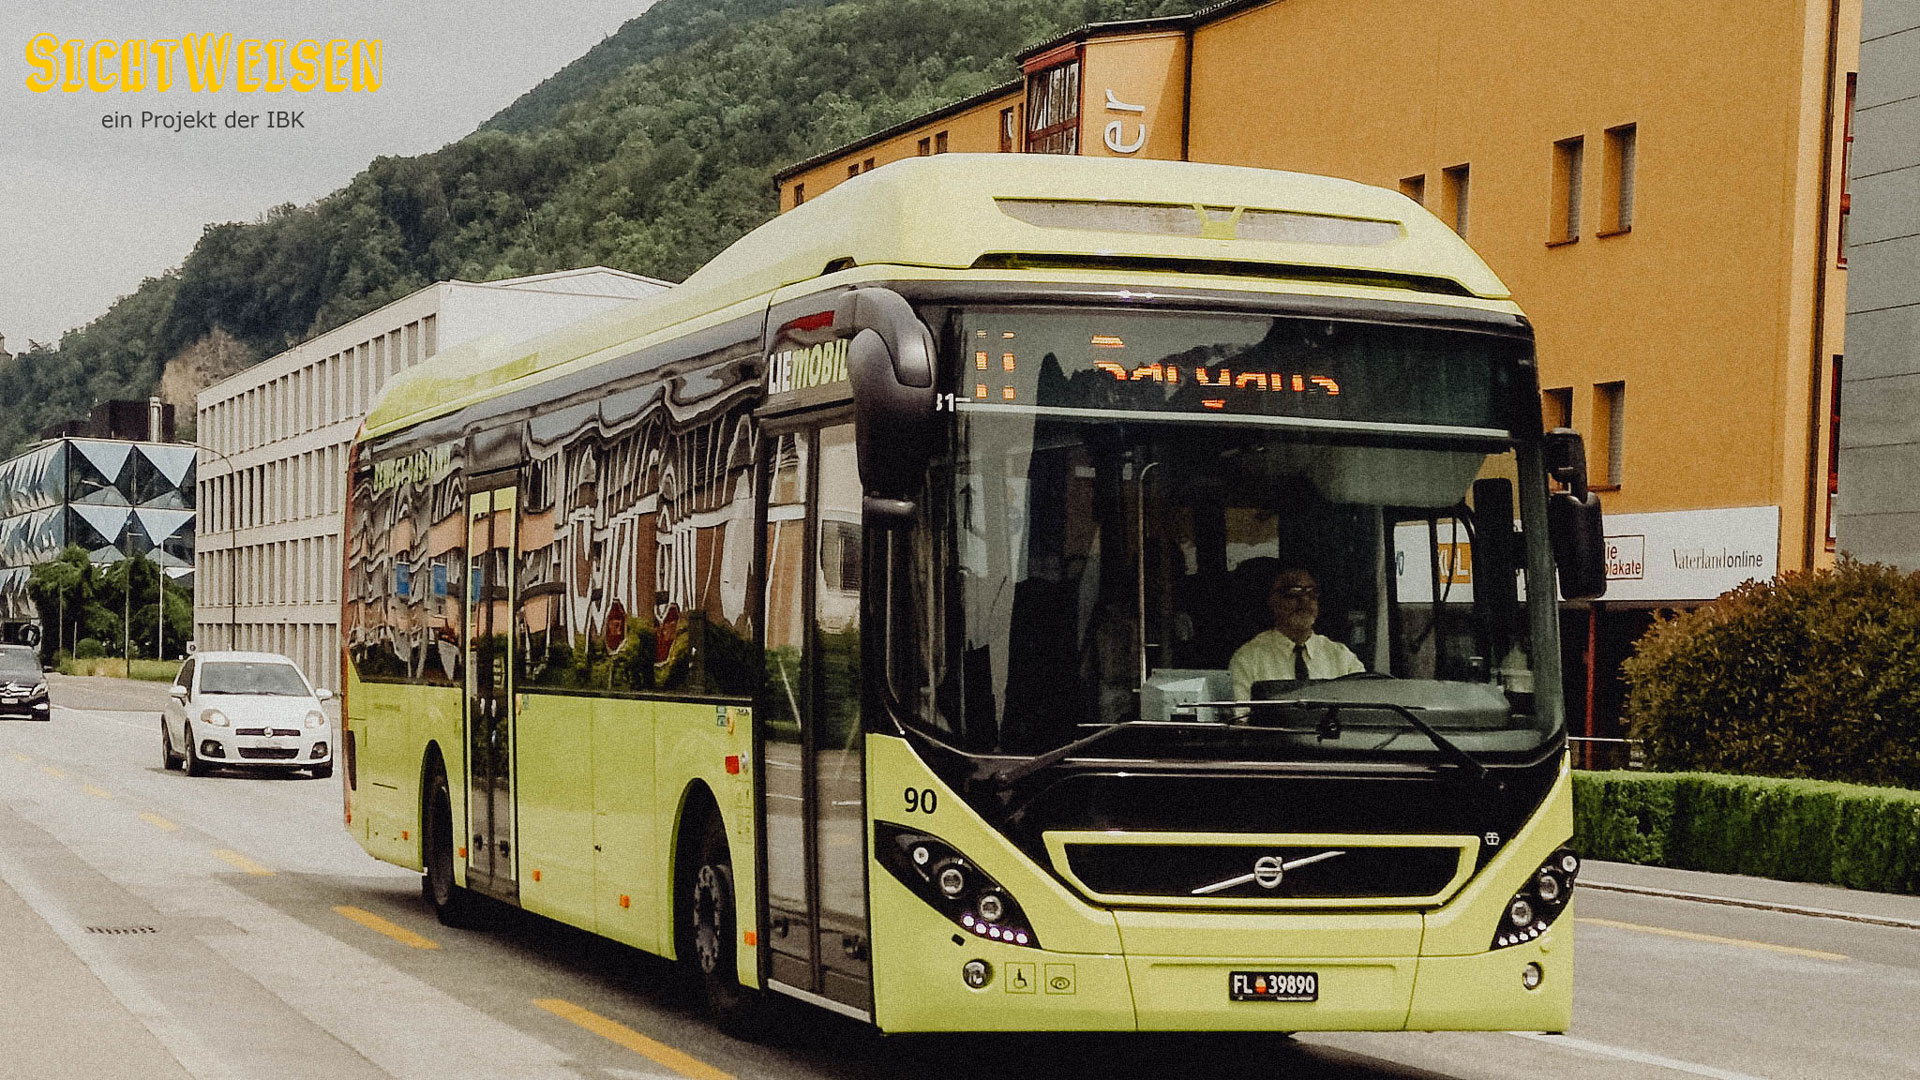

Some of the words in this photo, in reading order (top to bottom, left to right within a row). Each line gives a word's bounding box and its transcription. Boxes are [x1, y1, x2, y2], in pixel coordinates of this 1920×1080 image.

[1672, 547, 1764, 571] Vaterlandonline
[904, 787, 937, 814] 90
[1233, 974, 1253, 994] FL
[1268, 974, 1315, 994] 39890
